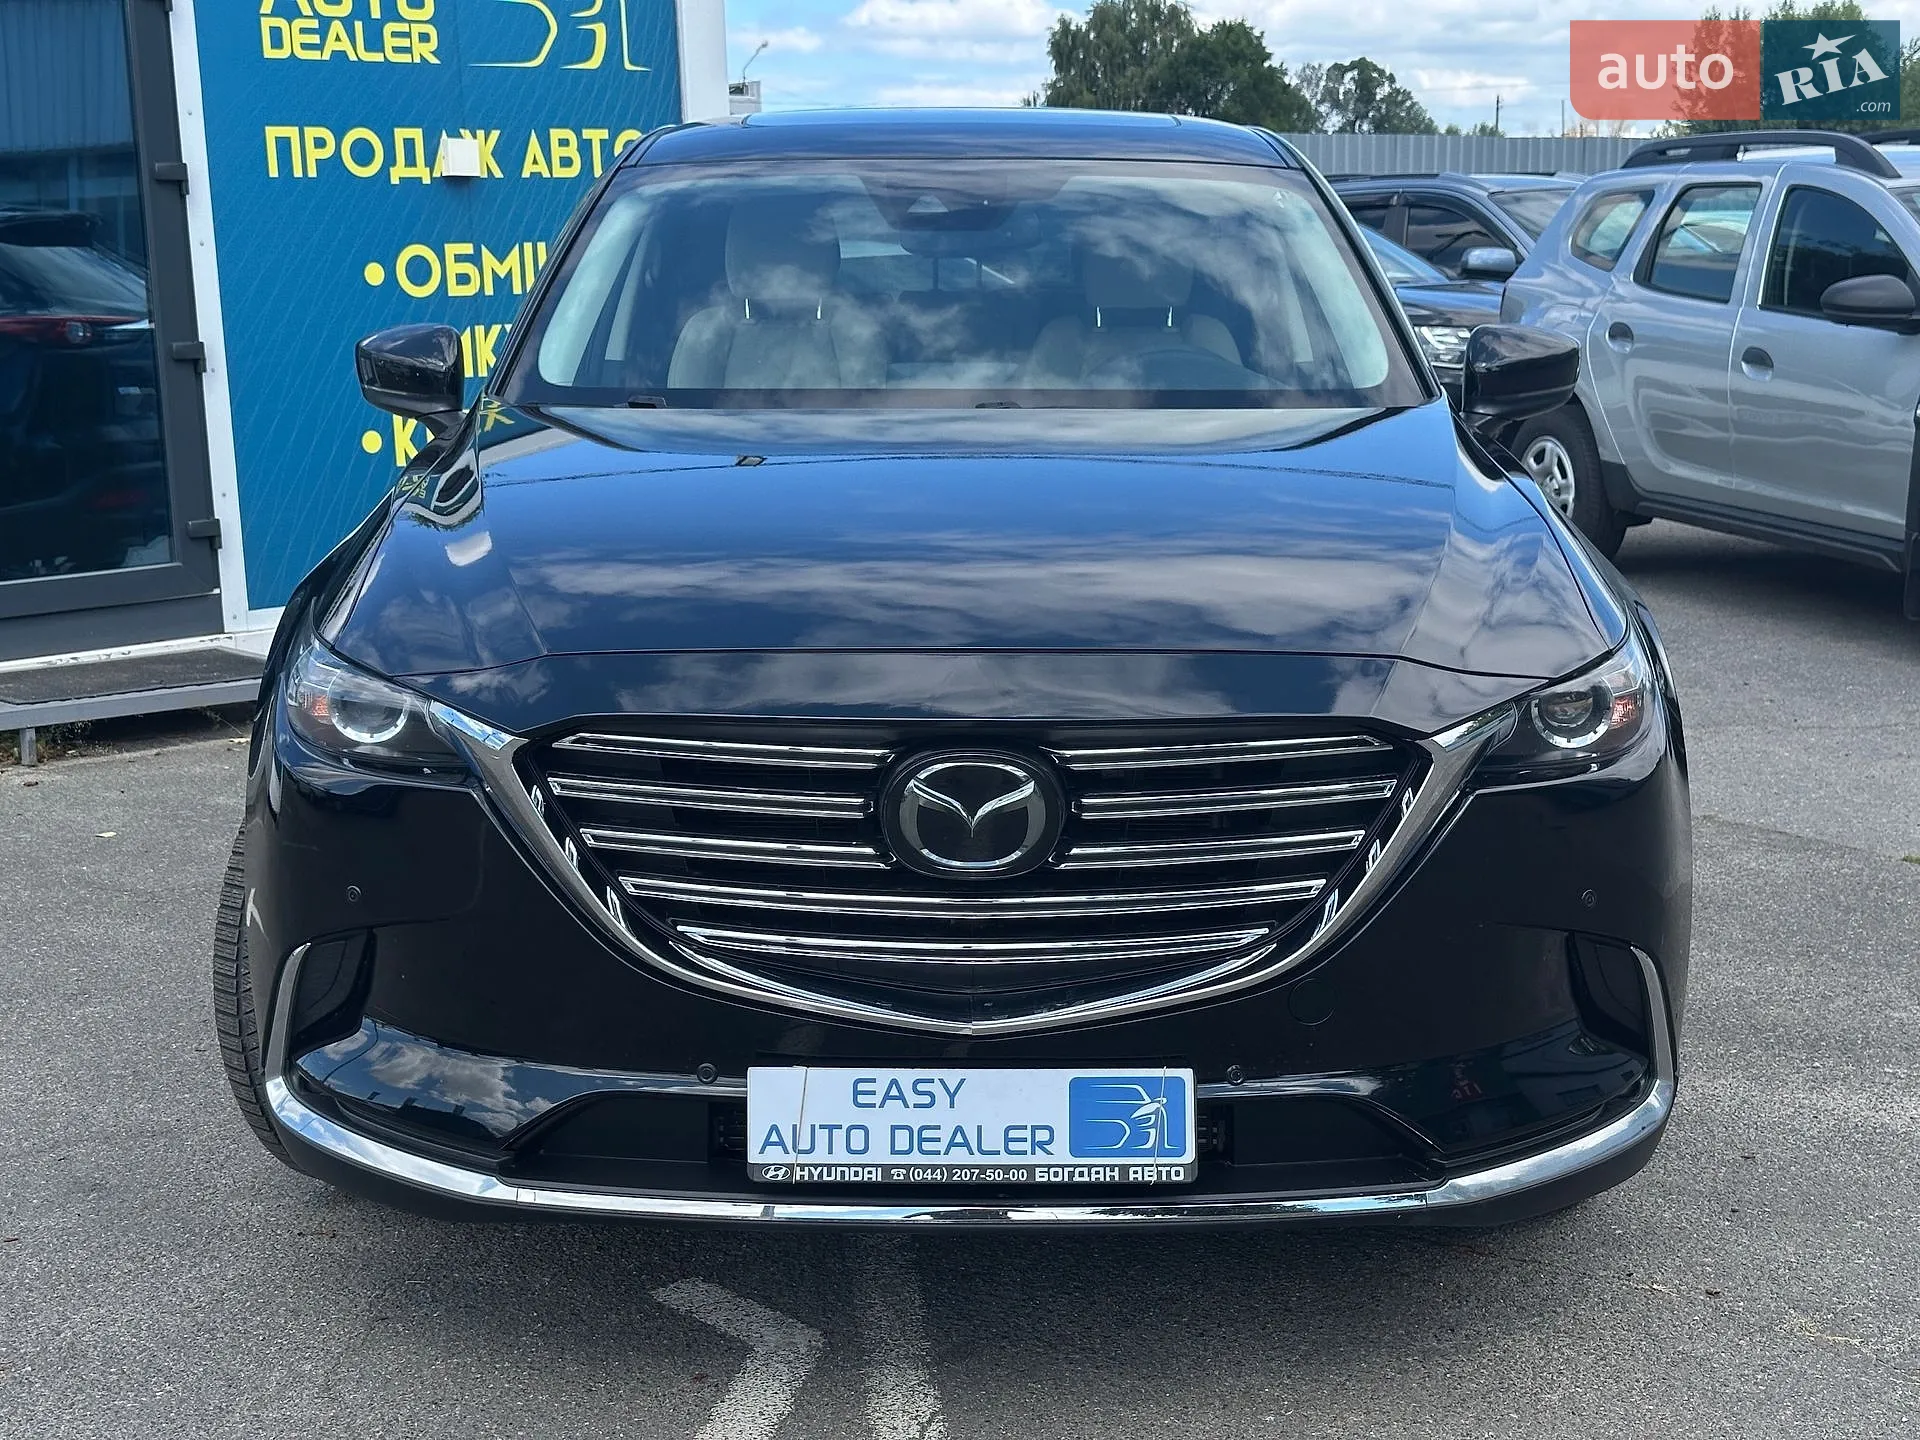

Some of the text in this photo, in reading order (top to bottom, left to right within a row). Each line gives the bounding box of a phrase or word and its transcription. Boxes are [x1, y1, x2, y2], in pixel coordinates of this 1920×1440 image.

[260, 16, 441, 64] DEALER
[264, 125, 504, 185] ПРОДЖ
[852, 1078, 967, 1109] EASY
[758, 1124, 1055, 1156] AUTO DEALER
[796, 1166, 1185, 1182] HYUNDAI (044) 207-50-00 БОГДАН АВТО
